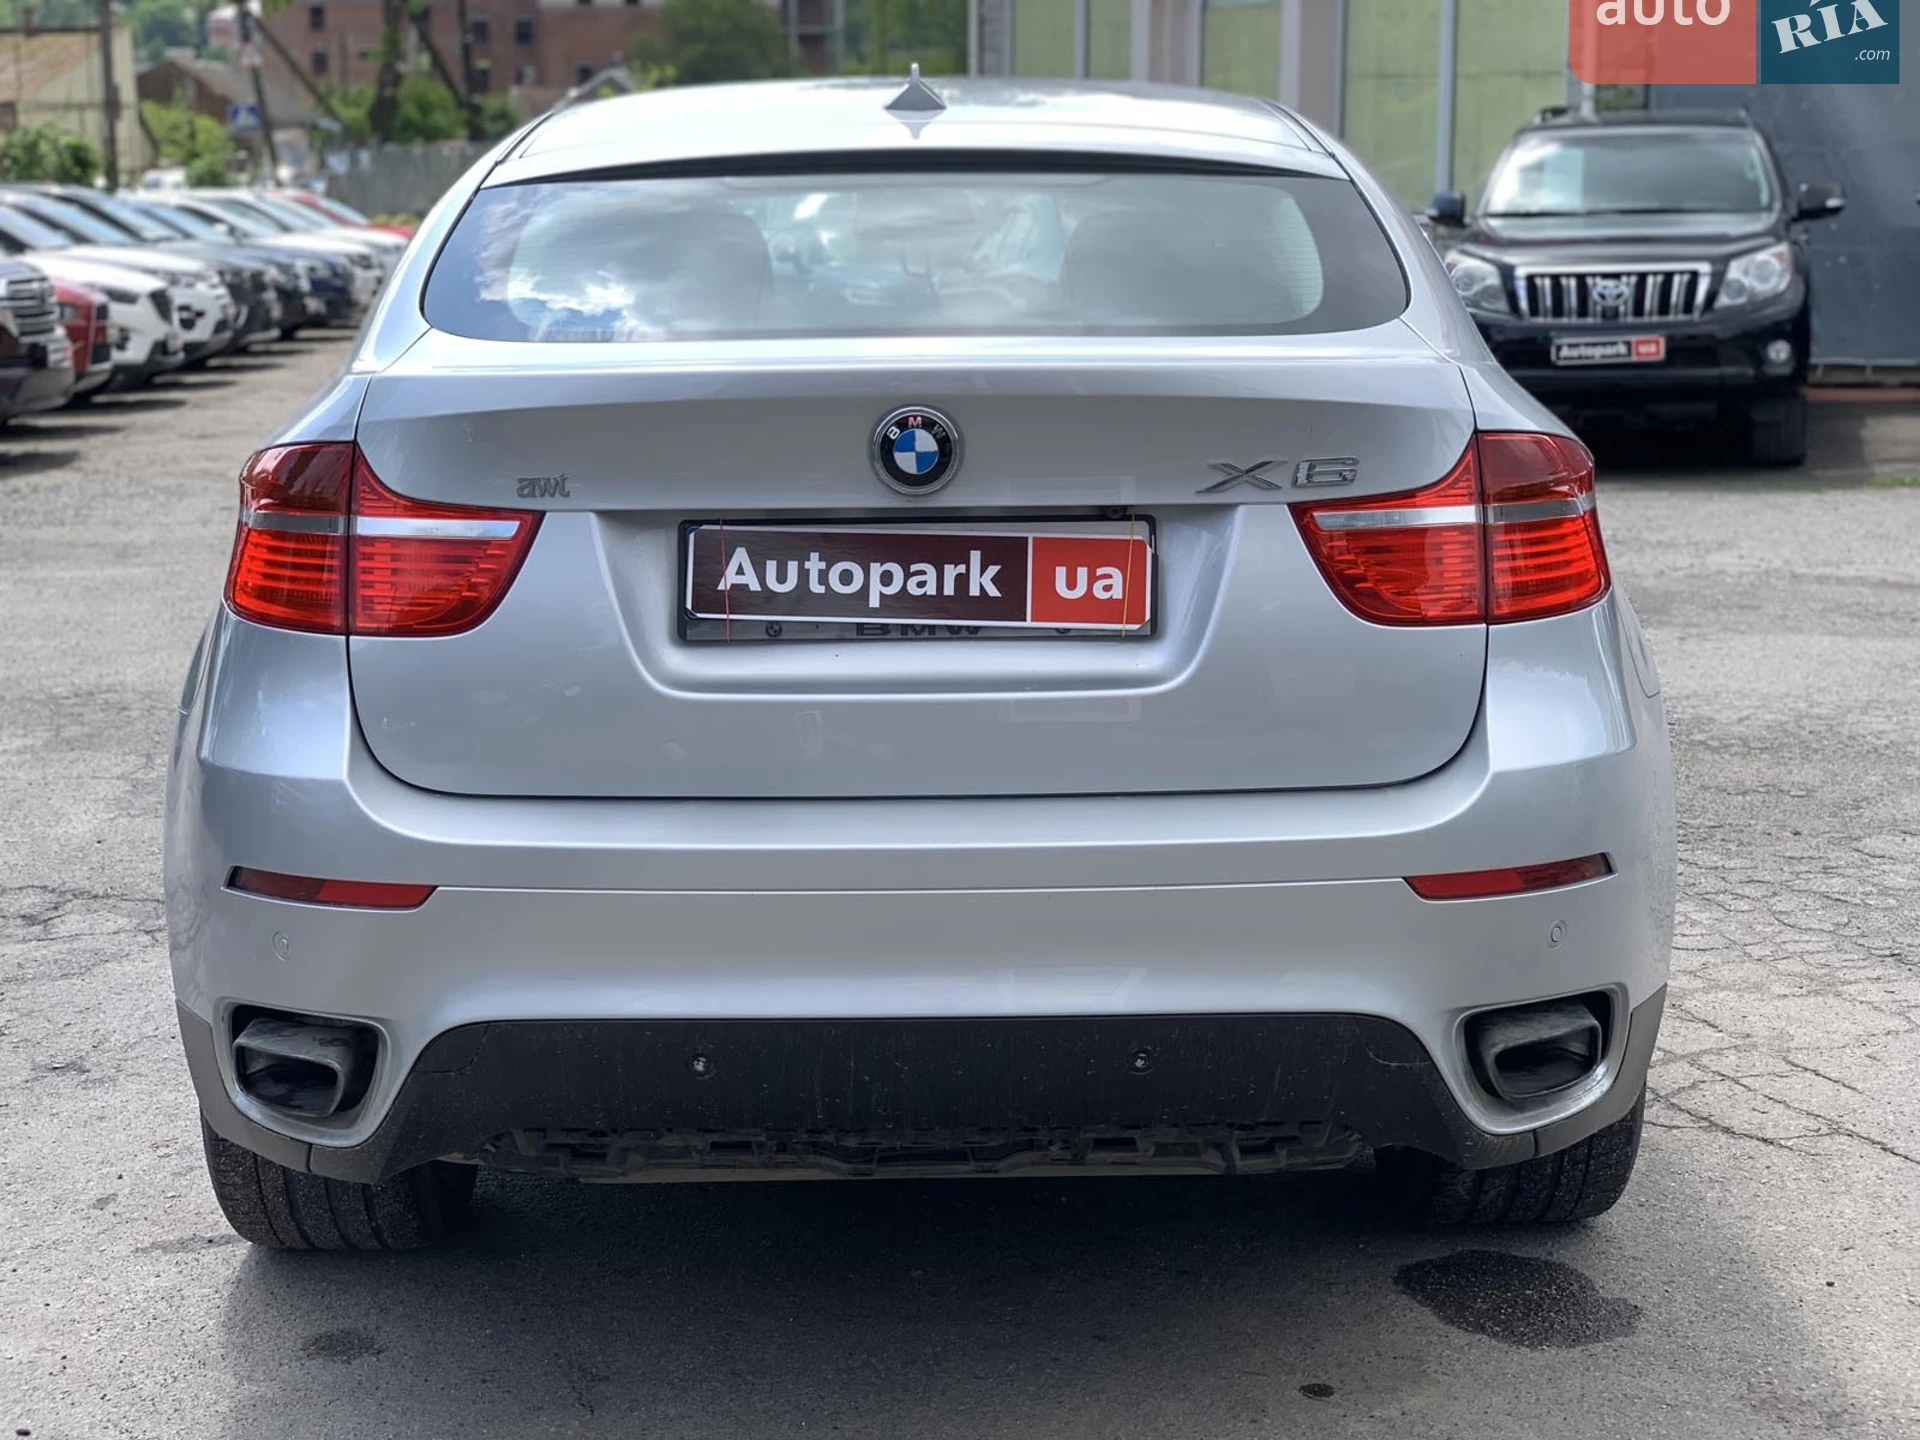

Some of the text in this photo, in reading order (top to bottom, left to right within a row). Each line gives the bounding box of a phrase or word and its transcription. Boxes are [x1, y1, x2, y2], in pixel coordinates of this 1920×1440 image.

[1559, 341, 1629, 359] Autopark
[886, 416, 946, 440] BMW
[1195, 456, 1361, 494] X6
[717, 546, 1124, 608] Autopark ua
[855, 622, 982, 637] BMW
